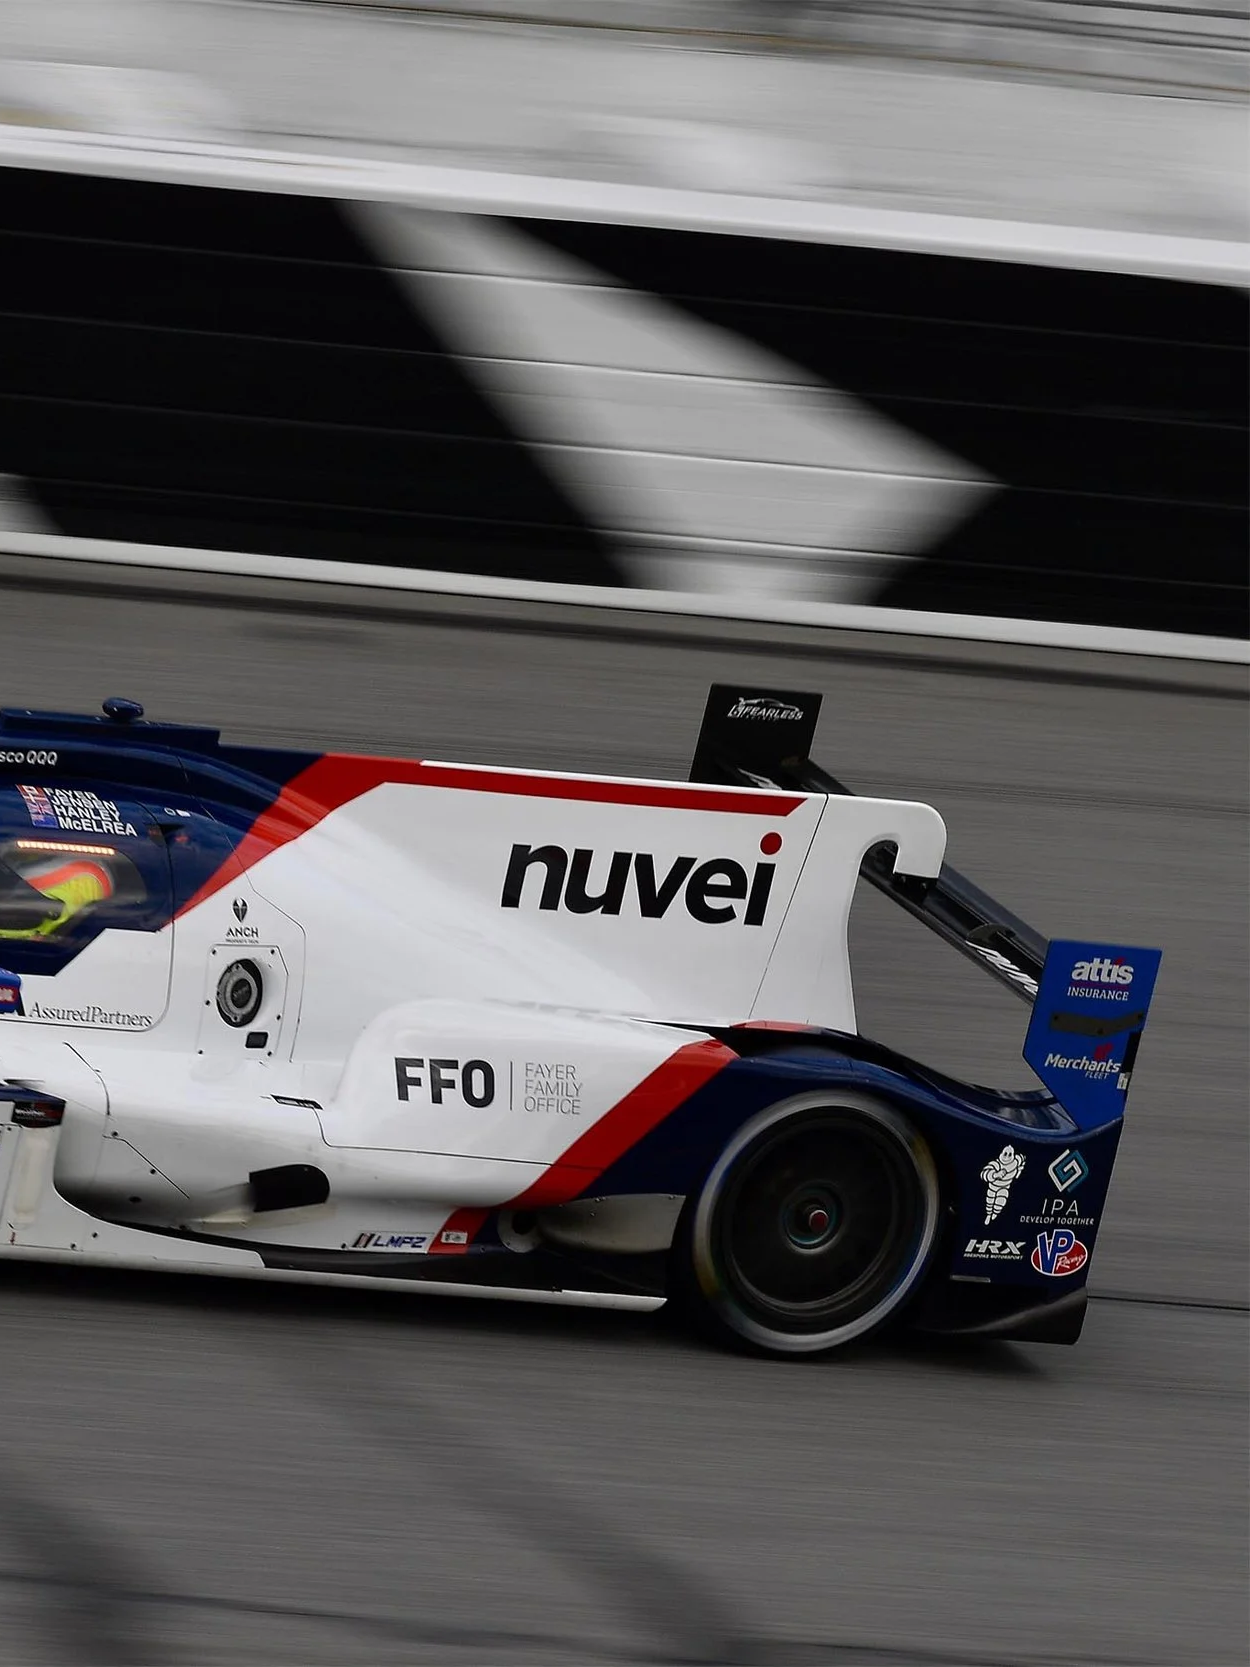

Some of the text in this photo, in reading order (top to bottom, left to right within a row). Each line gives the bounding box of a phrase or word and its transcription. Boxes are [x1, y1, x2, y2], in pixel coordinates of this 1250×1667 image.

[27, 750, 58, 766] QQQ
[53, 804, 120, 822] HANLEY
[58, 816, 138, 838] McELREA
[501, 832, 782, 926] nuvei
[1071, 957, 1134, 985] attis
[1067, 986, 1129, 1001] INSURANCE
[30, 1001, 153, 1027] AssuredPartners
[525, 1062, 576, 1080] FAYER
[1044, 1053, 1122, 1073] Merchants
[395, 1057, 495, 1109] FFO
[524, 1079, 583, 1098] FAMILY
[524, 1096, 581, 1115] OFFICE
[1042, 1198, 1079, 1216] IPA
[1019, 1215, 1095, 1226] DEVELOP TOGETHER
[373, 1235, 427, 1249] LMP2
[965, 1239, 1026, 1255] HRX
[1037, 1229, 1075, 1275] VP
